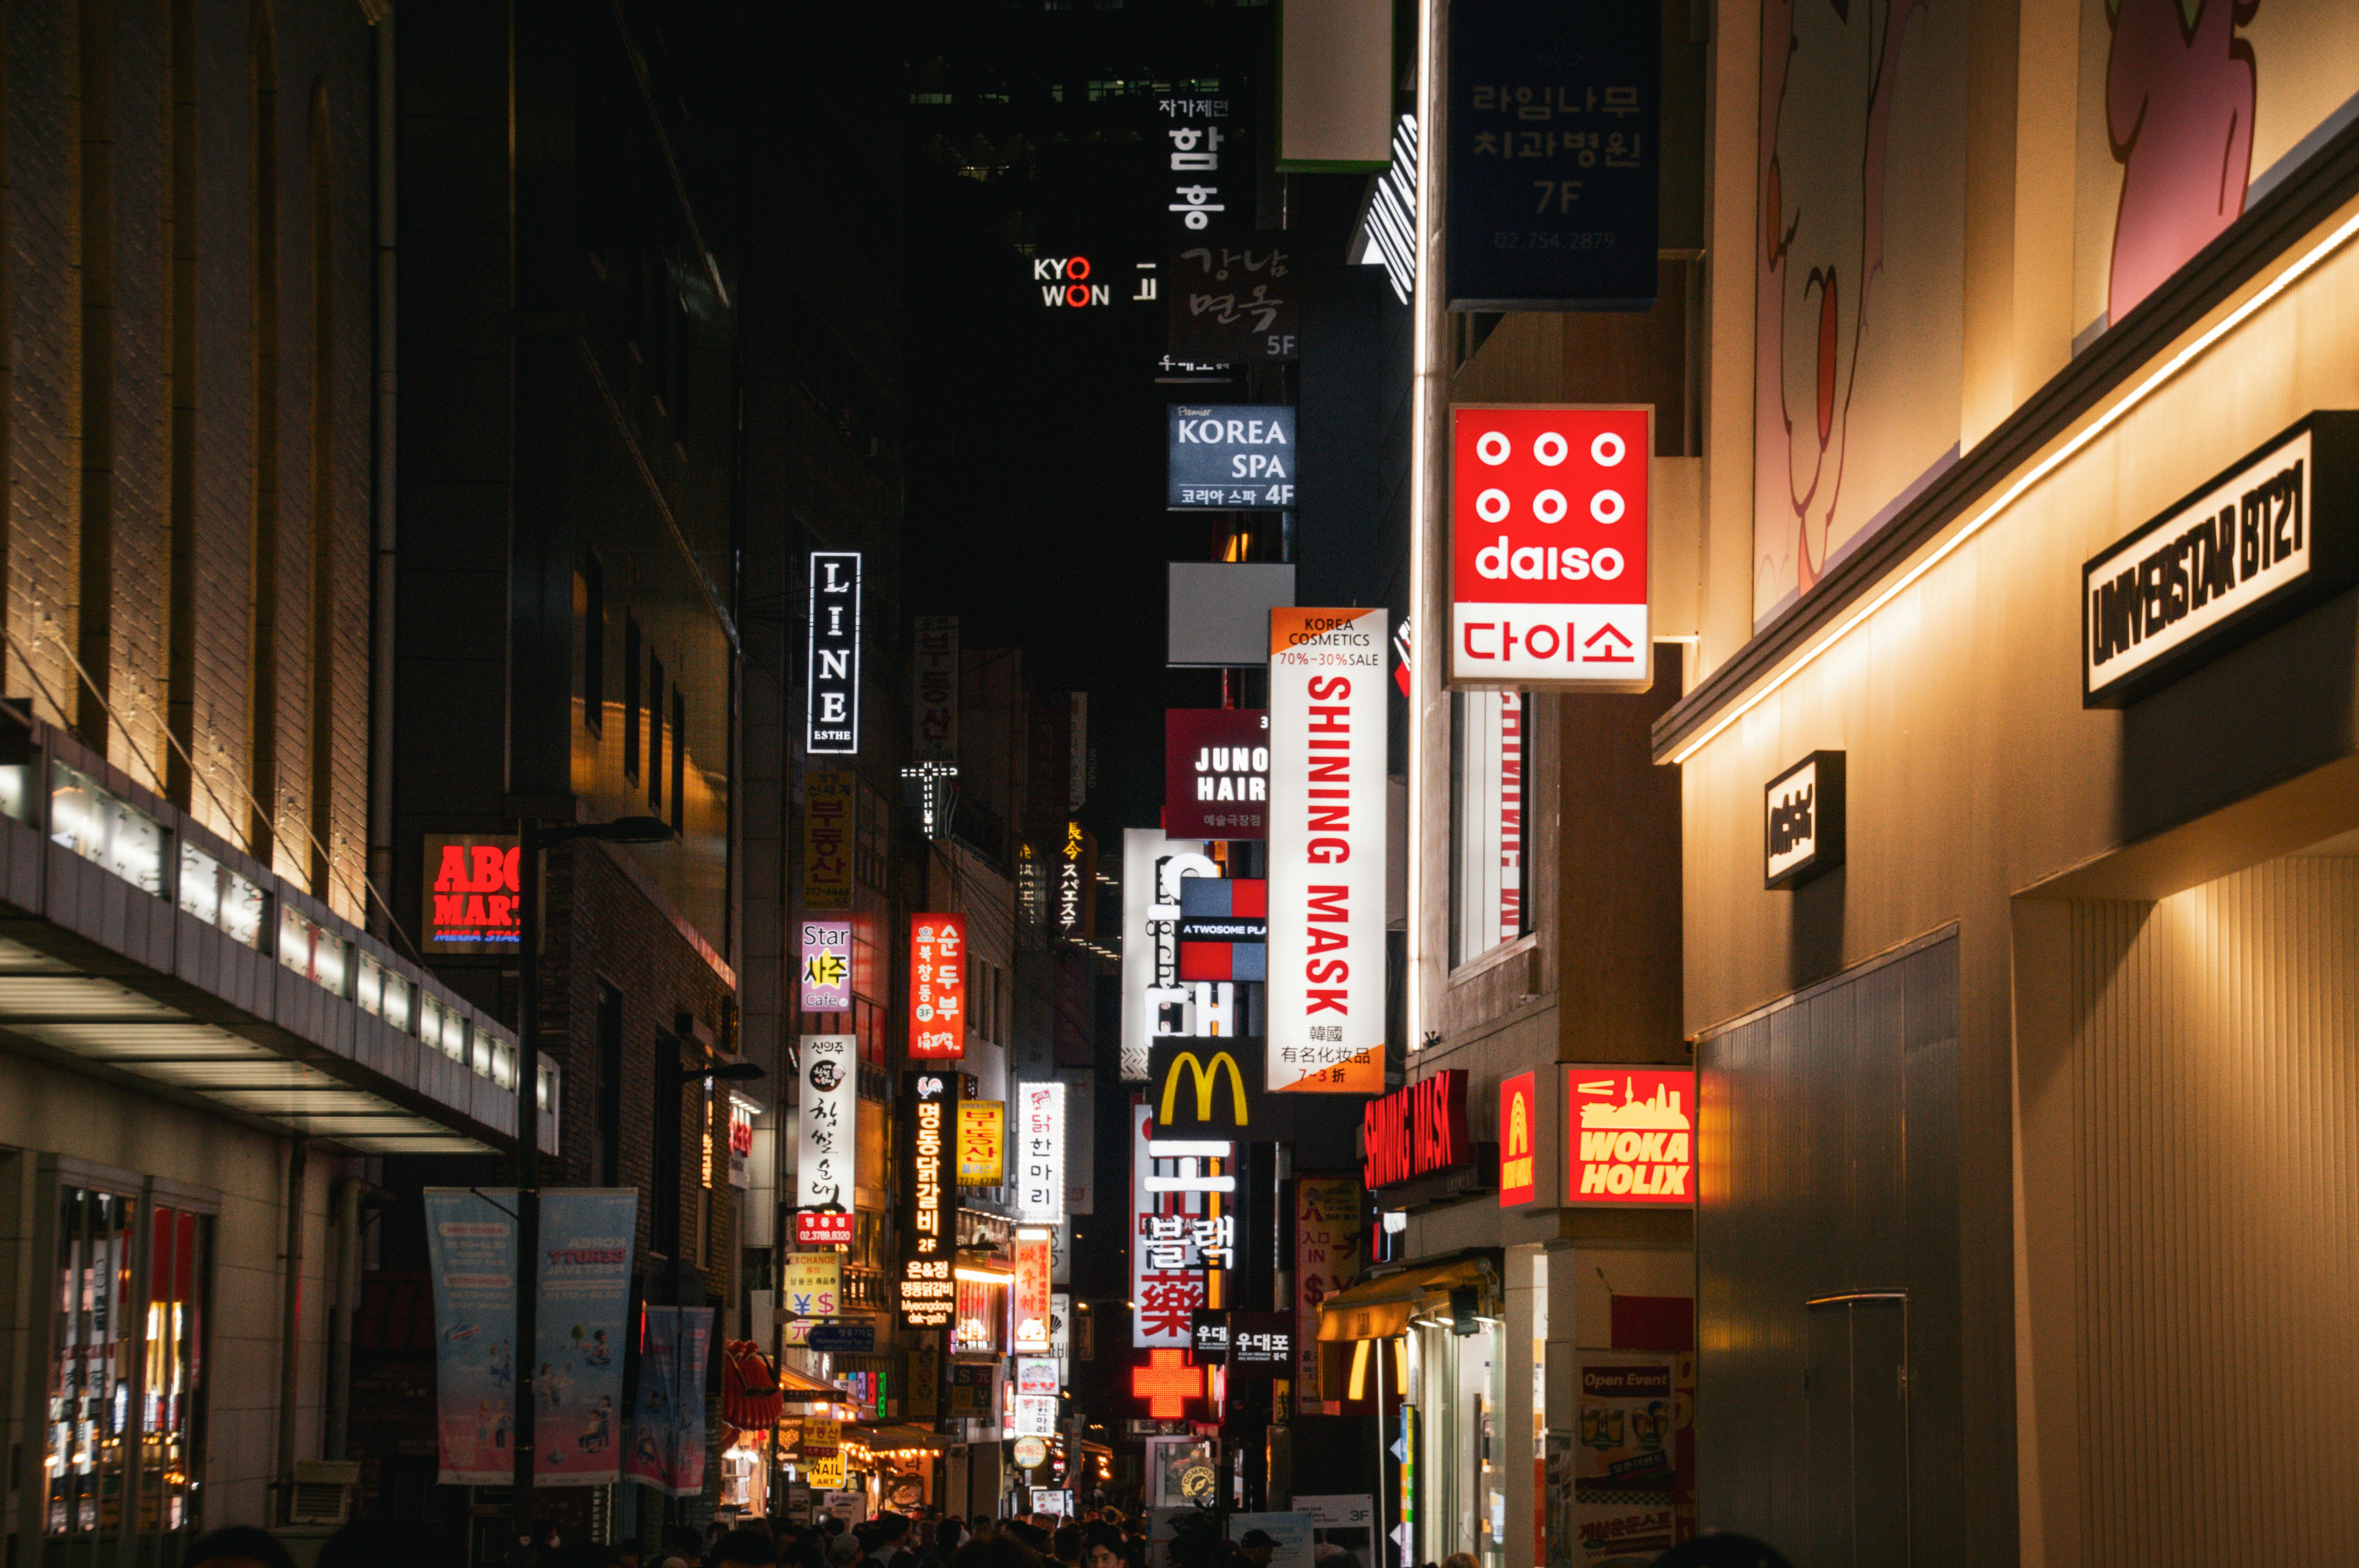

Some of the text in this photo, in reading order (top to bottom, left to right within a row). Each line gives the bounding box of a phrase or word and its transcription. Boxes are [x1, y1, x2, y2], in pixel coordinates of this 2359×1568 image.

[1159, 99, 1229, 118] 자가제면
[1472, 85, 1641, 120] 라임나무
[1472, 131, 1642, 168] 치과병원
[1169, 126, 1225, 230] 함흥
[1532, 180, 1583, 214] 7F
[1493, 232, 1615, 249] 02.754.2879
[1034, 256, 1090, 281] KYO
[1181, 247, 1288, 281] 강남
[1042, 284, 1109, 307] WON
[1189, 283, 1284, 334] 면옥
[1267, 335, 1294, 355] 5F
[1178, 420, 1287, 444] KOREA
[1232, 454, 1287, 478] SPA
[1181, 485, 1294, 505] 코리아 스파 4F
[1475, 535, 1625, 581] daiso
[2092, 458, 2304, 666] UNIVERSTAR BT21
[1305, 619, 1354, 631] KOREA
[818, 563, 850, 722] LINE
[1289, 633, 1370, 646] COSMETICS
[1463, 621, 1634, 662] 다이소
[920, 633, 951, 741] 부동산
[814, 731, 851, 740] ESTHE
[1195, 747, 1269, 772] JUNO
[1197, 777, 1266, 801] HAIR
[1203, 814, 1261, 827] 예술극장점
[811, 800, 846, 883] 부동산
[1305, 676, 1351, 1016] SHINING MASK
[1060, 864, 1079, 931] スパエステ
[804, 926, 849, 945] Star
[1183, 925, 1192, 933] A
[1192, 925, 1245, 935] TWOSOME
[803, 956, 848, 984] 사주
[918, 945, 933, 1002] 북창동
[936, 924, 960, 1021] 순두부
[806, 993, 837, 1006] Cafe
[919, 1009, 931, 1017] 3F
[1309, 1025, 1343, 1042] 韓國
[811, 1041, 844, 1054] 신의주
[964, 1111, 997, 1162] 부동산
[1363, 1069, 1452, 1191] SHINING MASK
[1580, 1131, 1688, 1162] WOKA
[916, 1102, 941, 1236] 명동닭갈비
[1580, 1164, 1690, 1195] HOLIX
[918, 1238, 936, 1252] 2F
[1309, 1249, 1325, 1263] IN
[789, 1256, 836, 1265] EXCHANGE
[901, 1281, 953, 1297] 명동닭갈비
[901, 1300, 953, 1313] Myeongdong
[908, 1313, 947, 1325] dak-galbi
[1236, 1332, 1289, 1352] 우대포
[1272, 1352, 1287, 1361] 블랙
[1584, 1372, 1668, 1388] Open Event
[805, 1426, 838, 1439] 부동산
[1016, 1446, 1045, 1455] 부동산
[812, 1463, 841, 1476] NAIL
[1350, 1510, 1370, 1522] 3F
